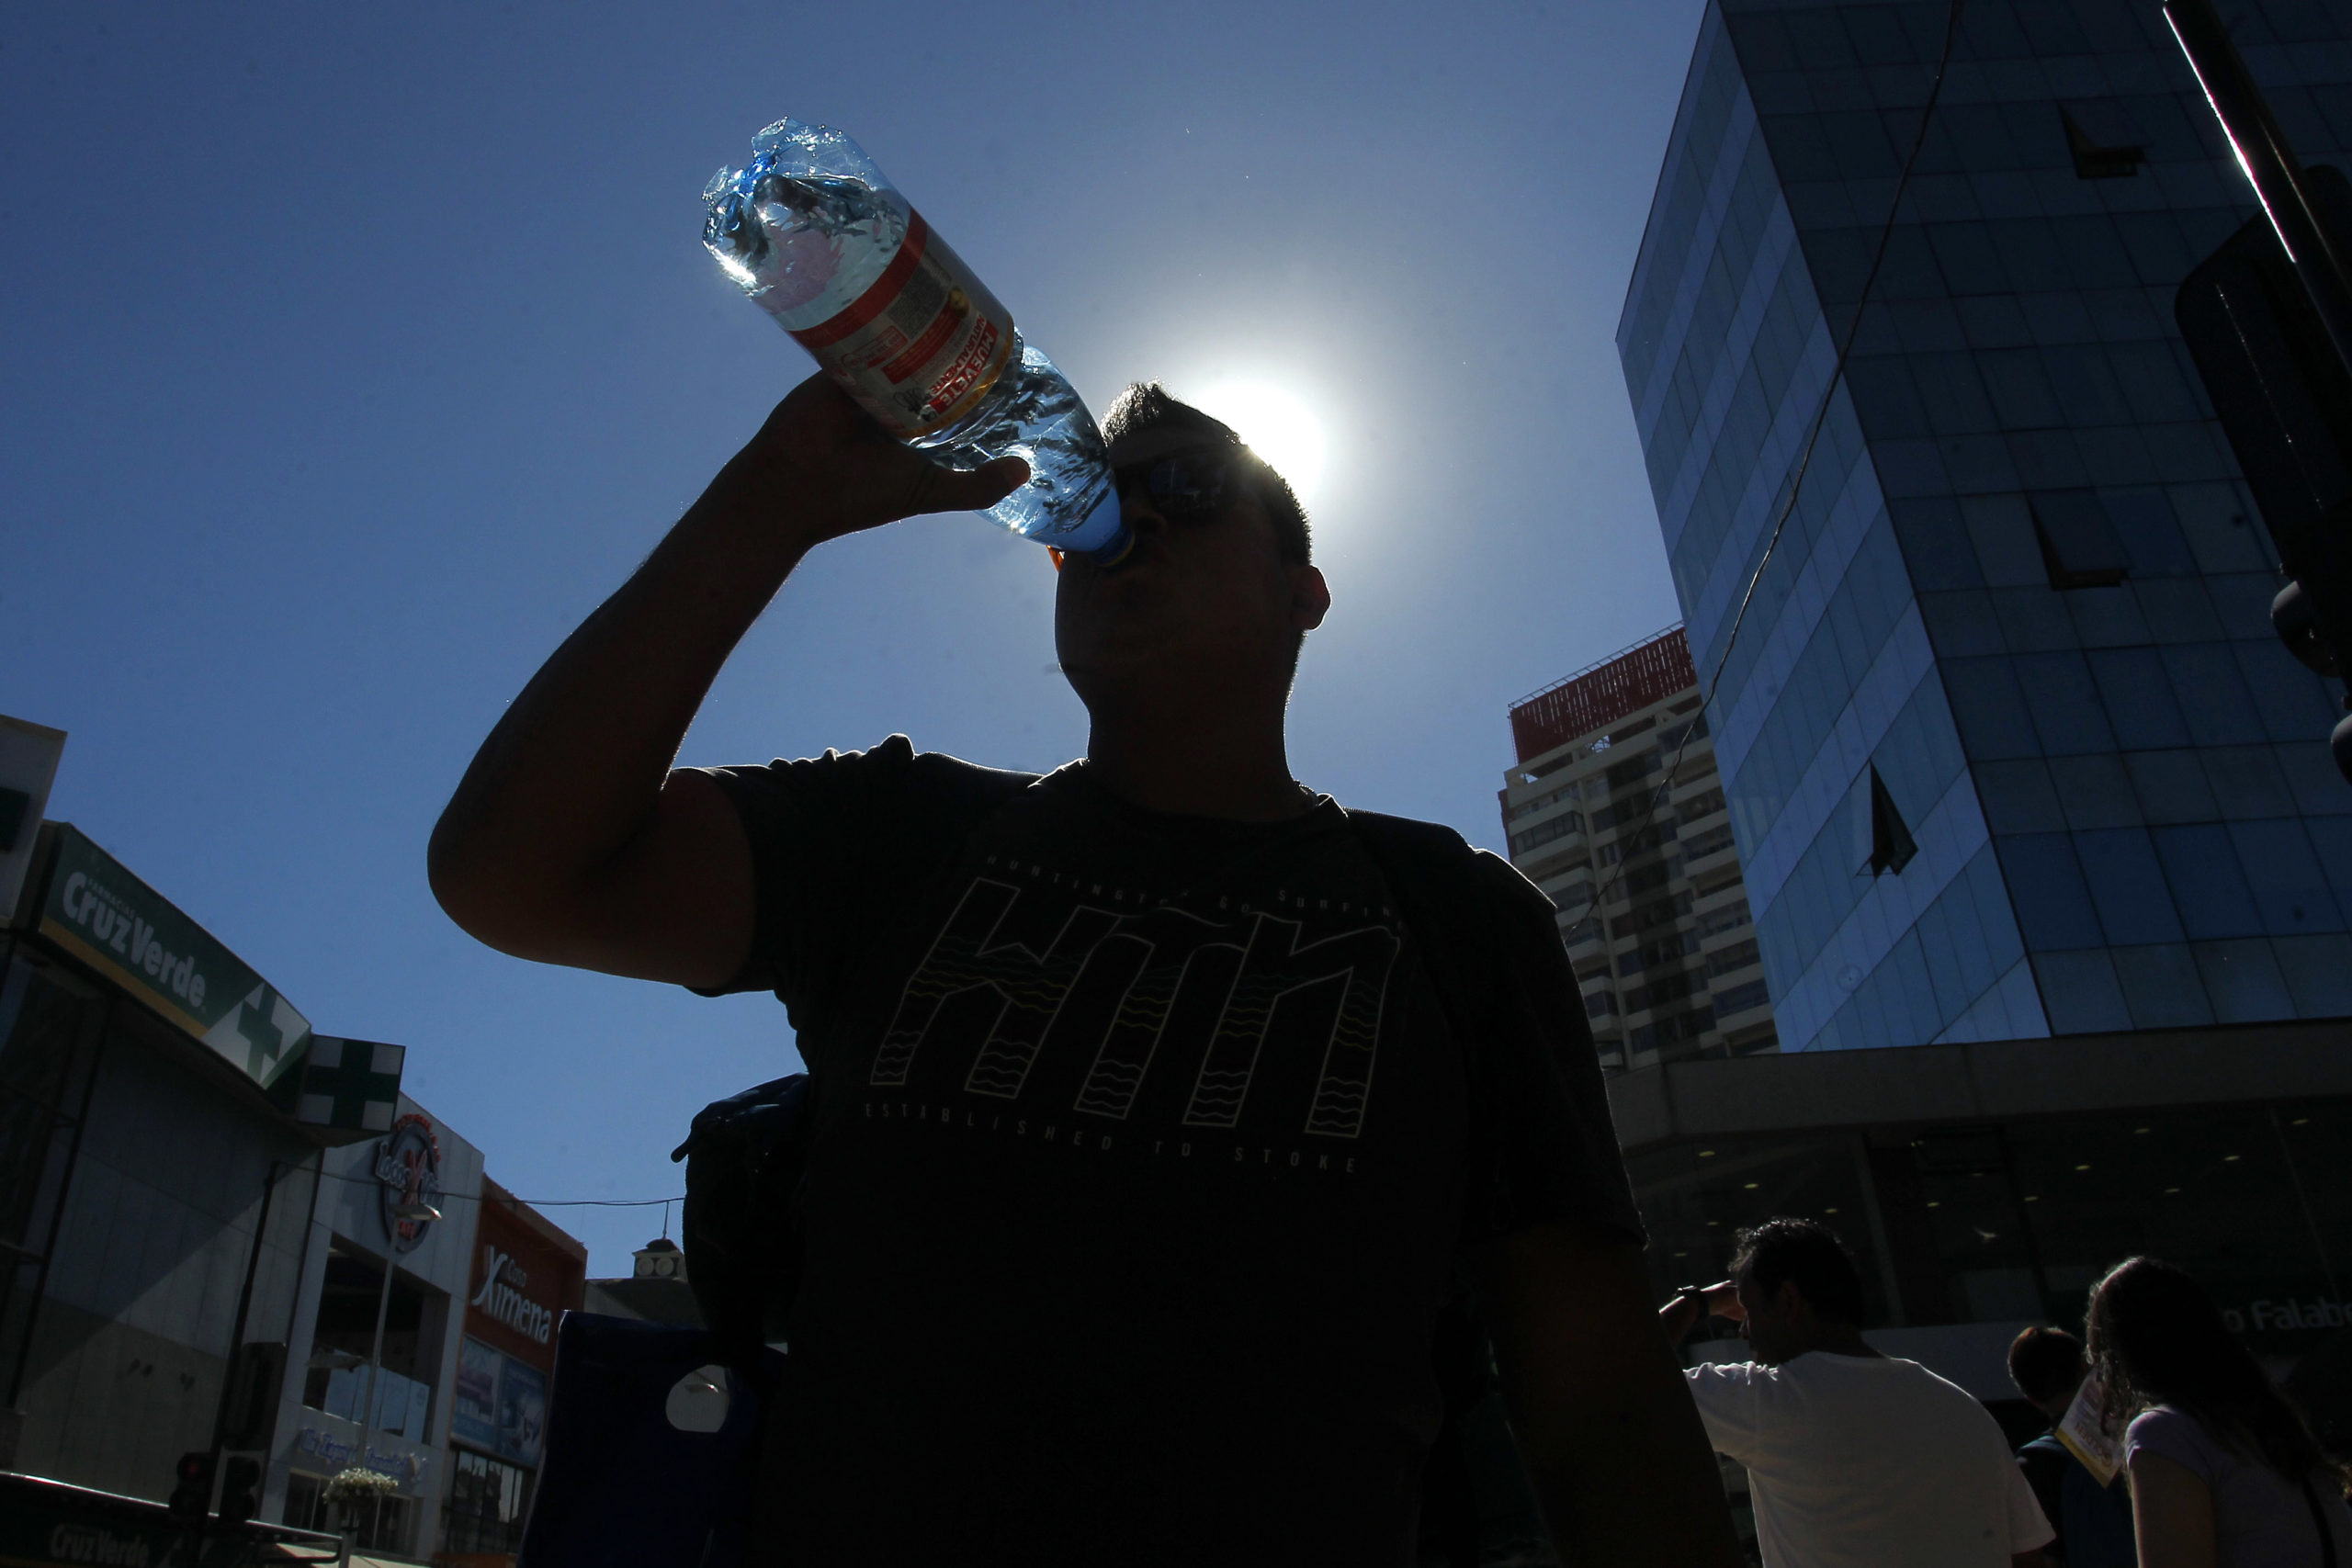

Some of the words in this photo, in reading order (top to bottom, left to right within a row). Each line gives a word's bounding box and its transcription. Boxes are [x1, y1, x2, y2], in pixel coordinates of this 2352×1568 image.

[928, 314, 987, 396] NATURALMENTE
[940, 329, 995, 407] MUEVETE
[864, 1101, 1113, 1151] ESTABLISHED
[1153, 1140, 1192, 1158] TO
[1234, 1146, 1358, 1174] STOKE
[471, 1243, 552, 1345] Ximena
